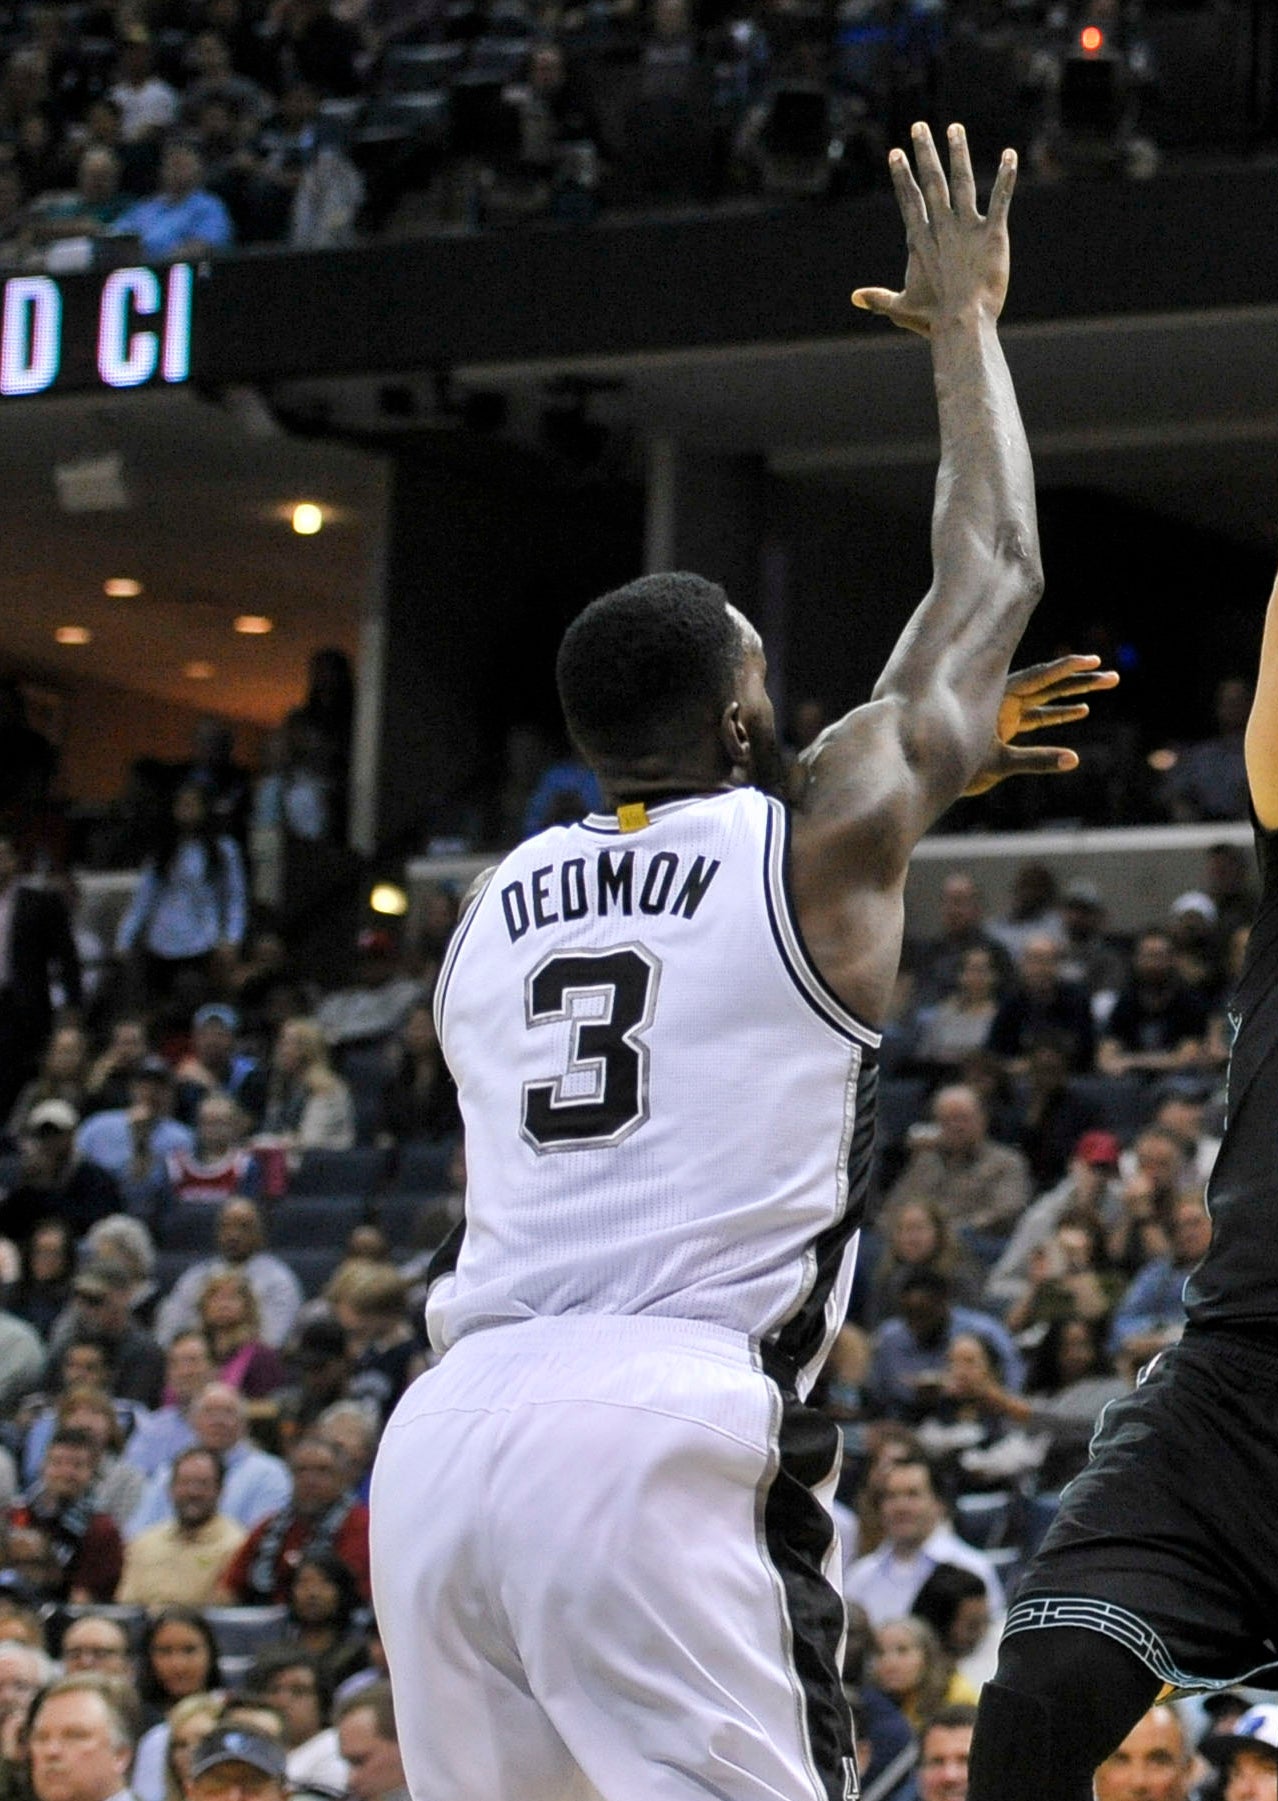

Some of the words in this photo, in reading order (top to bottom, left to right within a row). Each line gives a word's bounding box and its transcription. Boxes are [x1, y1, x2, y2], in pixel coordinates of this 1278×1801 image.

[0, 275, 62, 395] D
[97, 263, 193, 388] CI
[501, 850, 721, 944] DEDMON
[518, 940, 663, 1157] 3
